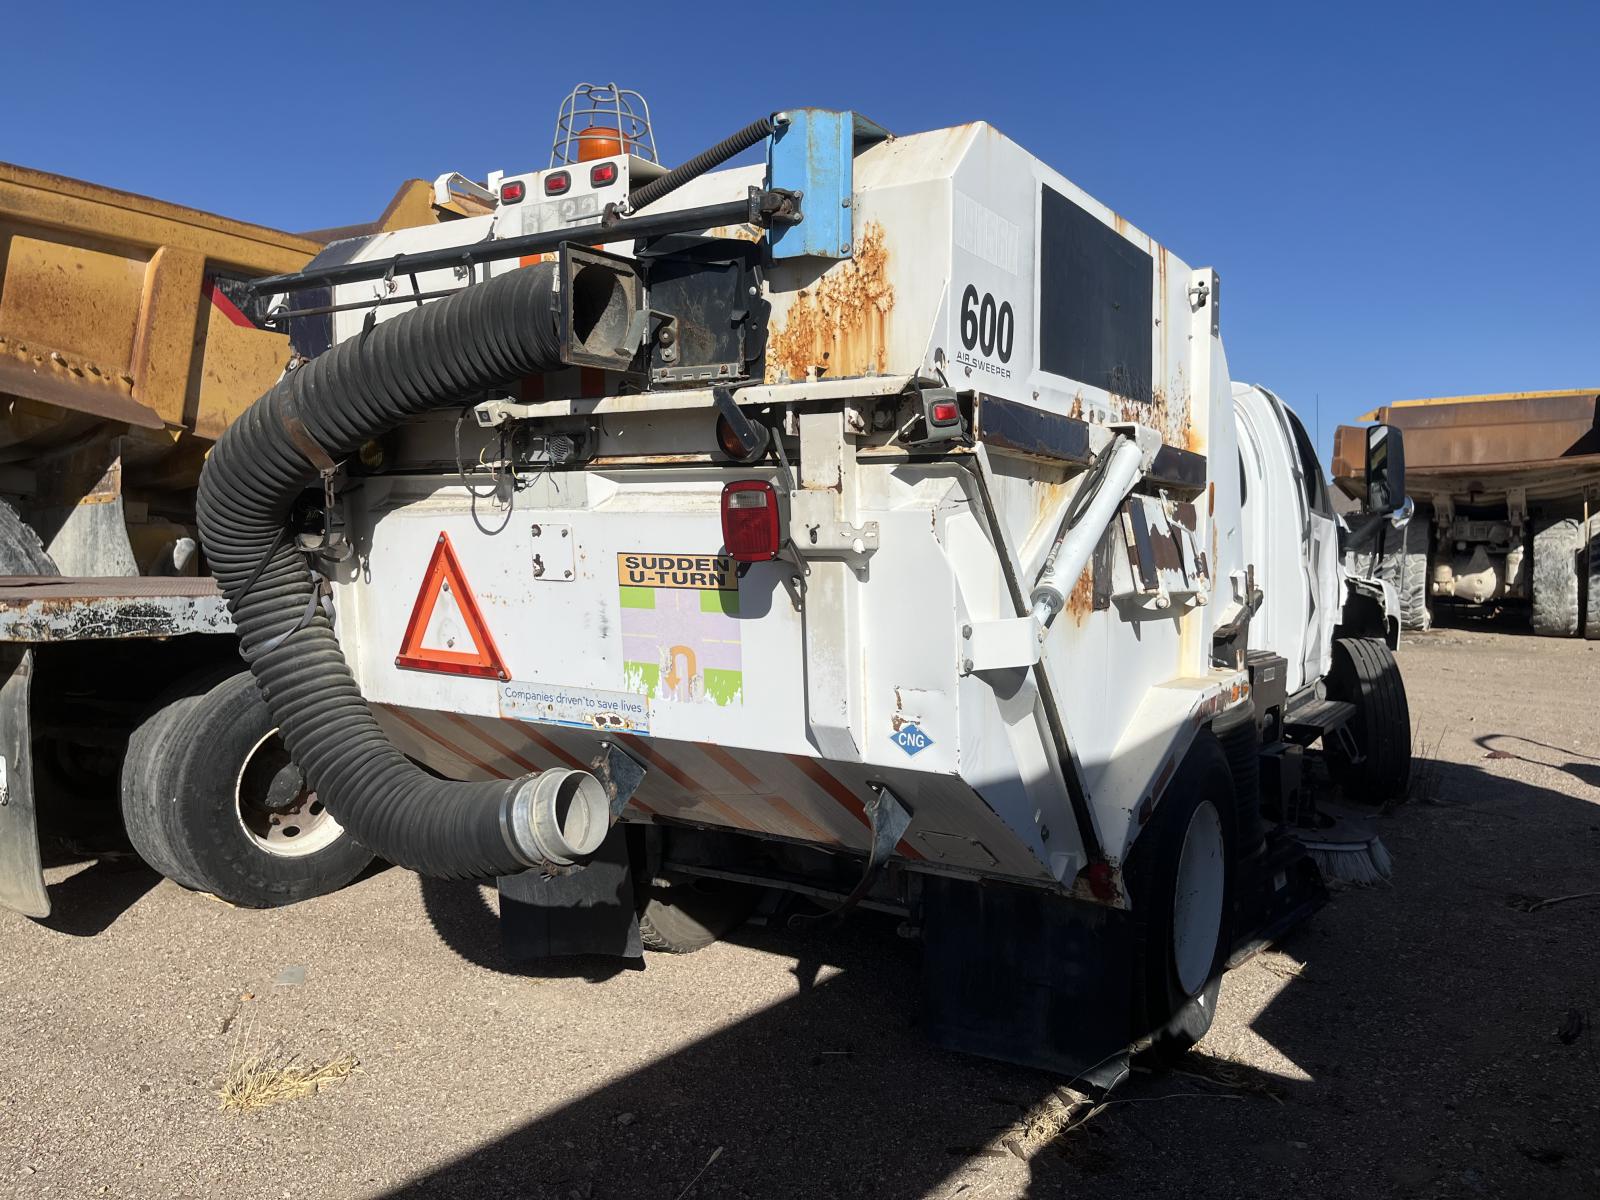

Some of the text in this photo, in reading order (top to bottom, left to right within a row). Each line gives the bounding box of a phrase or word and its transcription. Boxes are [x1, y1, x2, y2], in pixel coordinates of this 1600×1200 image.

[960, 283, 1014, 364] 600
[956, 351, 1011, 379] AIR SWEEPER
[625, 556, 729, 571] SUDDEN
[629, 571, 726, 586] U-TURN
[504, 687, 642, 713] Companies driven to save lives
[898, 732, 925, 747] CNG
